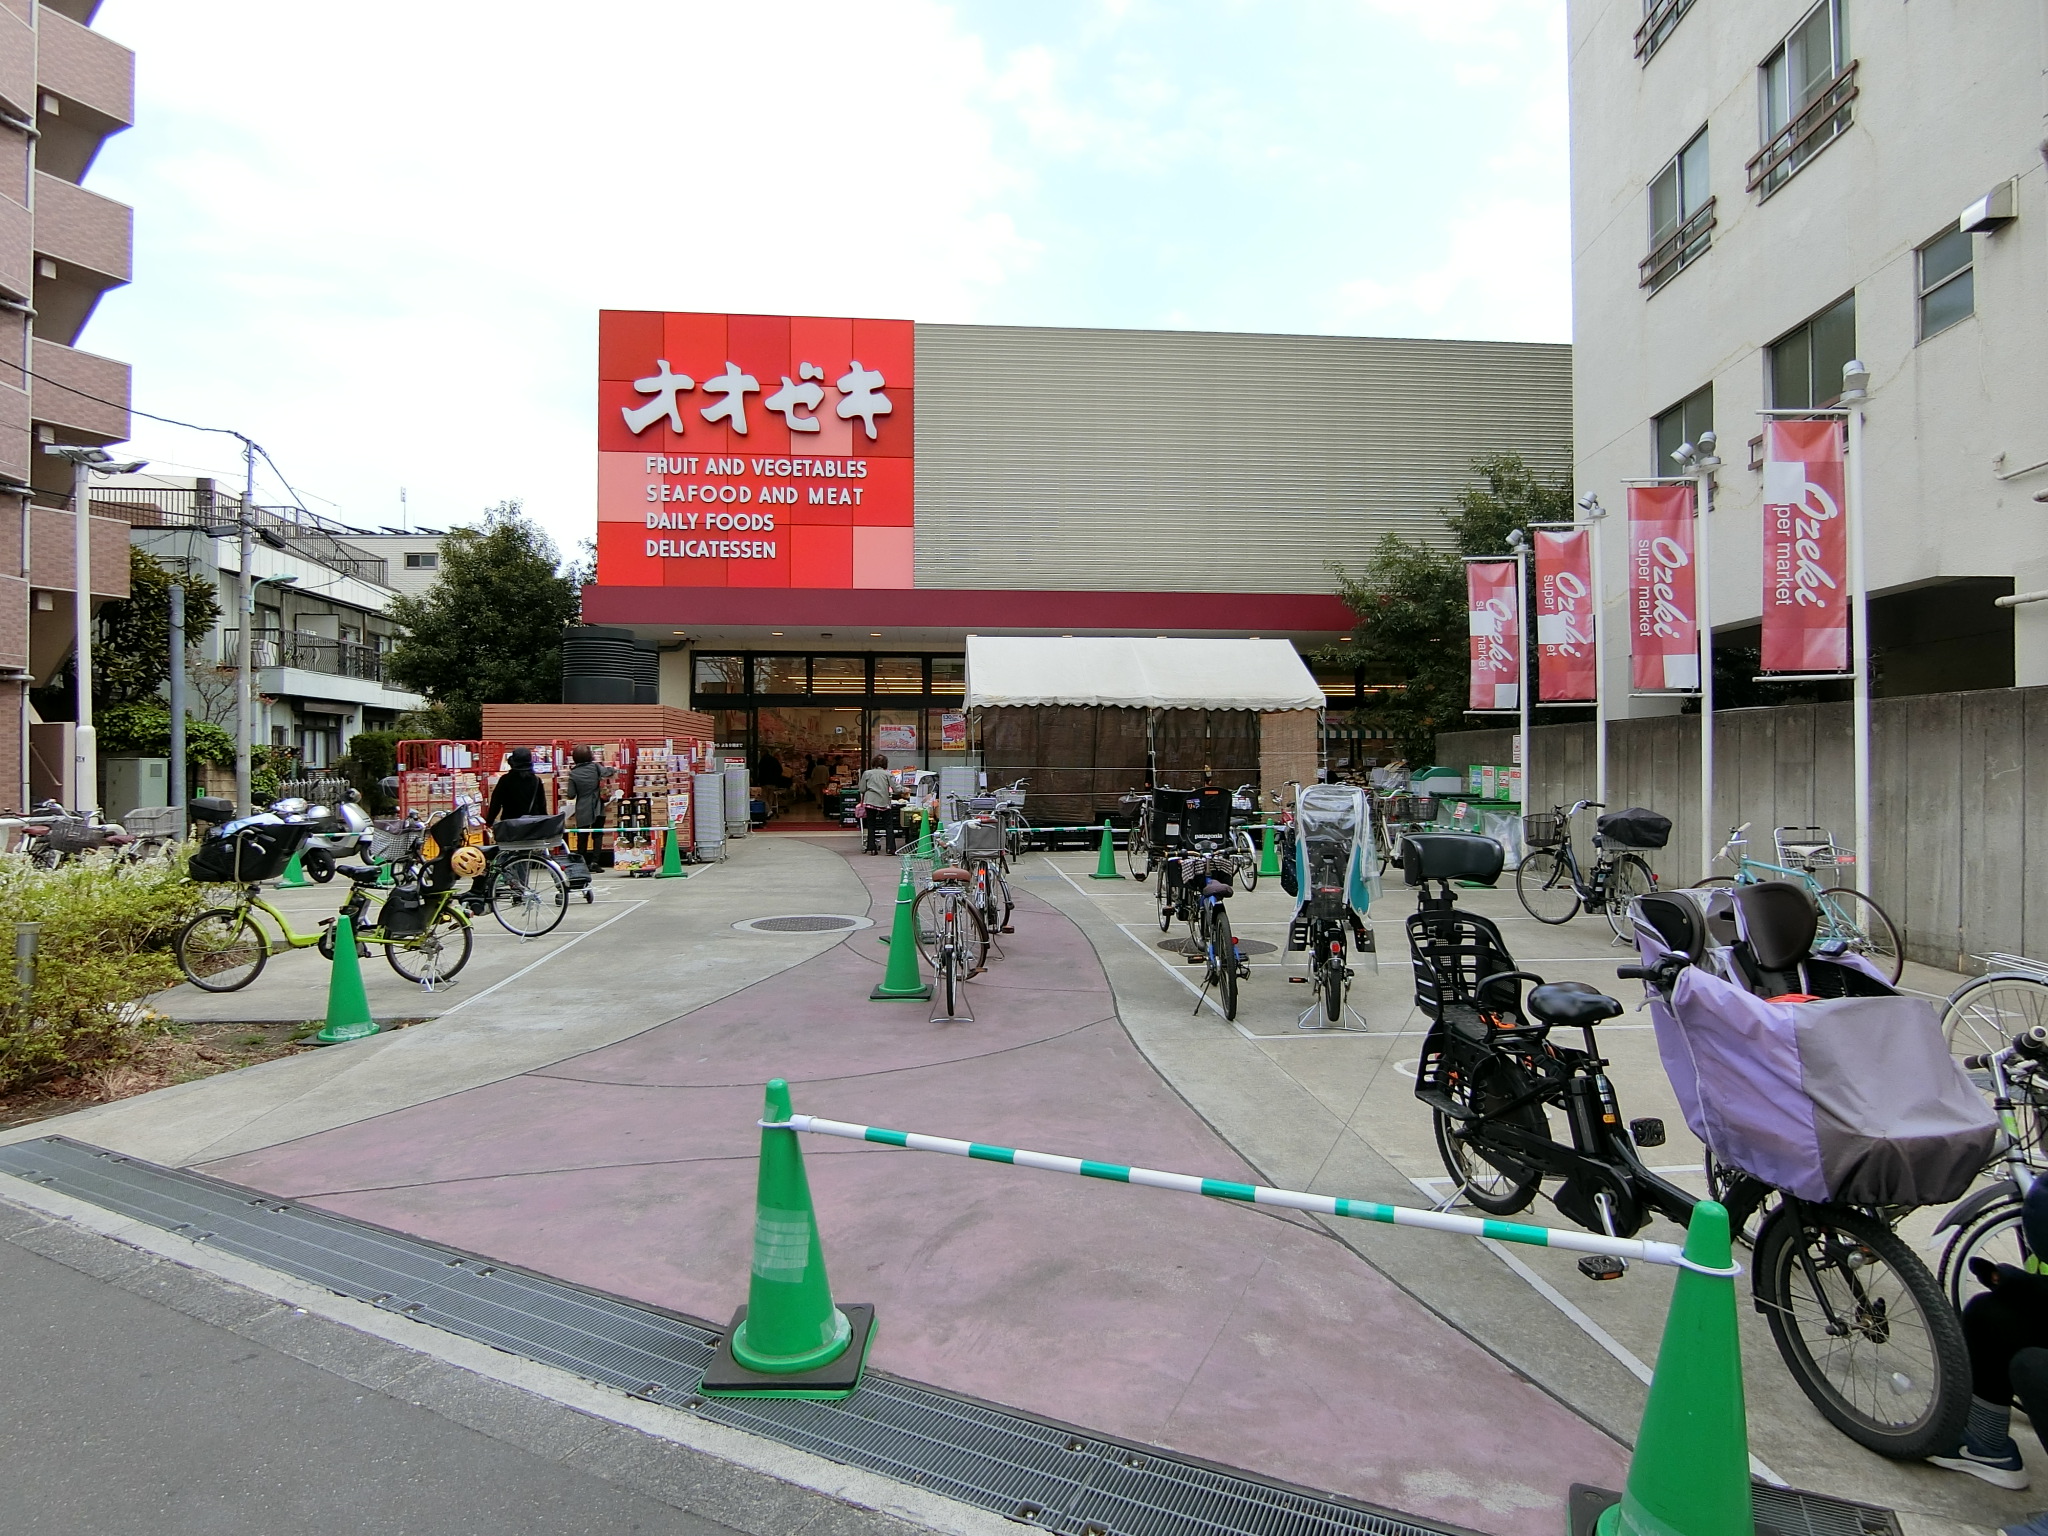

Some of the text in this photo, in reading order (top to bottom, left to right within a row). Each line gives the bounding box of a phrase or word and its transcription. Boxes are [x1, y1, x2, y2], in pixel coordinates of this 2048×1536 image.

[621, 359, 893, 440] オオゼキ
[646, 457, 867, 478] FRUIT AND VEGETABLES
[646, 485, 863, 505] SEAFOOD AND MEAT
[646, 513, 775, 532] DAILY FOODS
[646, 540, 776, 558] DELICATESSEN
[1772, 502, 1793, 605] per market
[1794, 482, 1838, 608] Ozeki
[1540, 574, 1554, 610] super
[1556, 571, 1589, 658] Ozeki
[1635, 539, 1652, 637] super market
[1652, 536, 1689, 639] Ozeki
